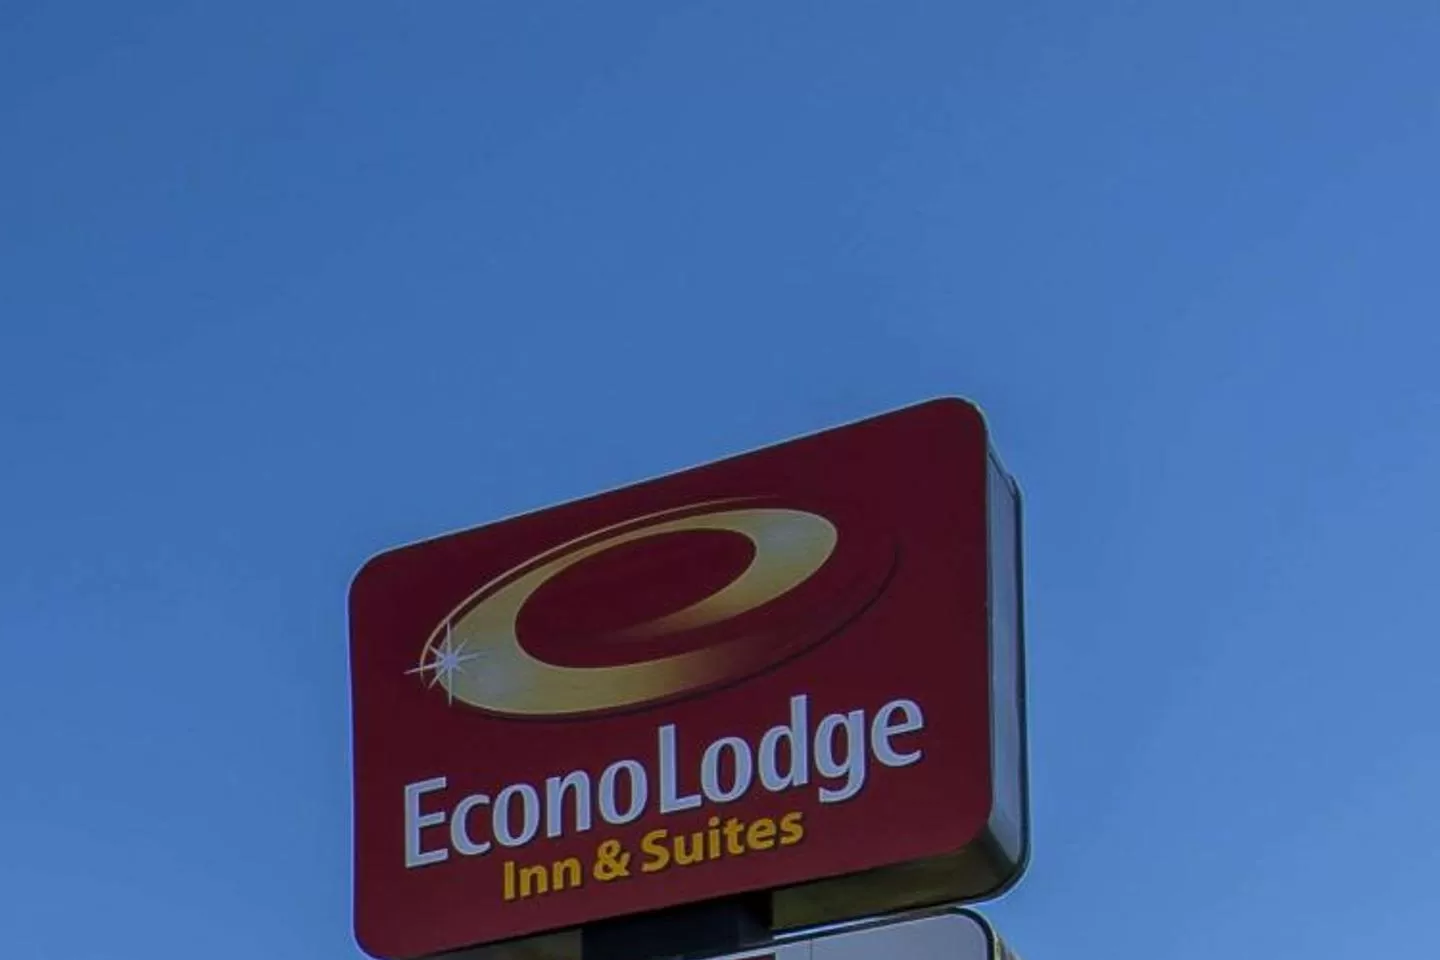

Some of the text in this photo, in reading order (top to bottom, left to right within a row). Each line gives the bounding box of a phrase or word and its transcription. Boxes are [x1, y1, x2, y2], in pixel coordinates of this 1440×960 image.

[502, 810, 804, 901] Inn & Suites
